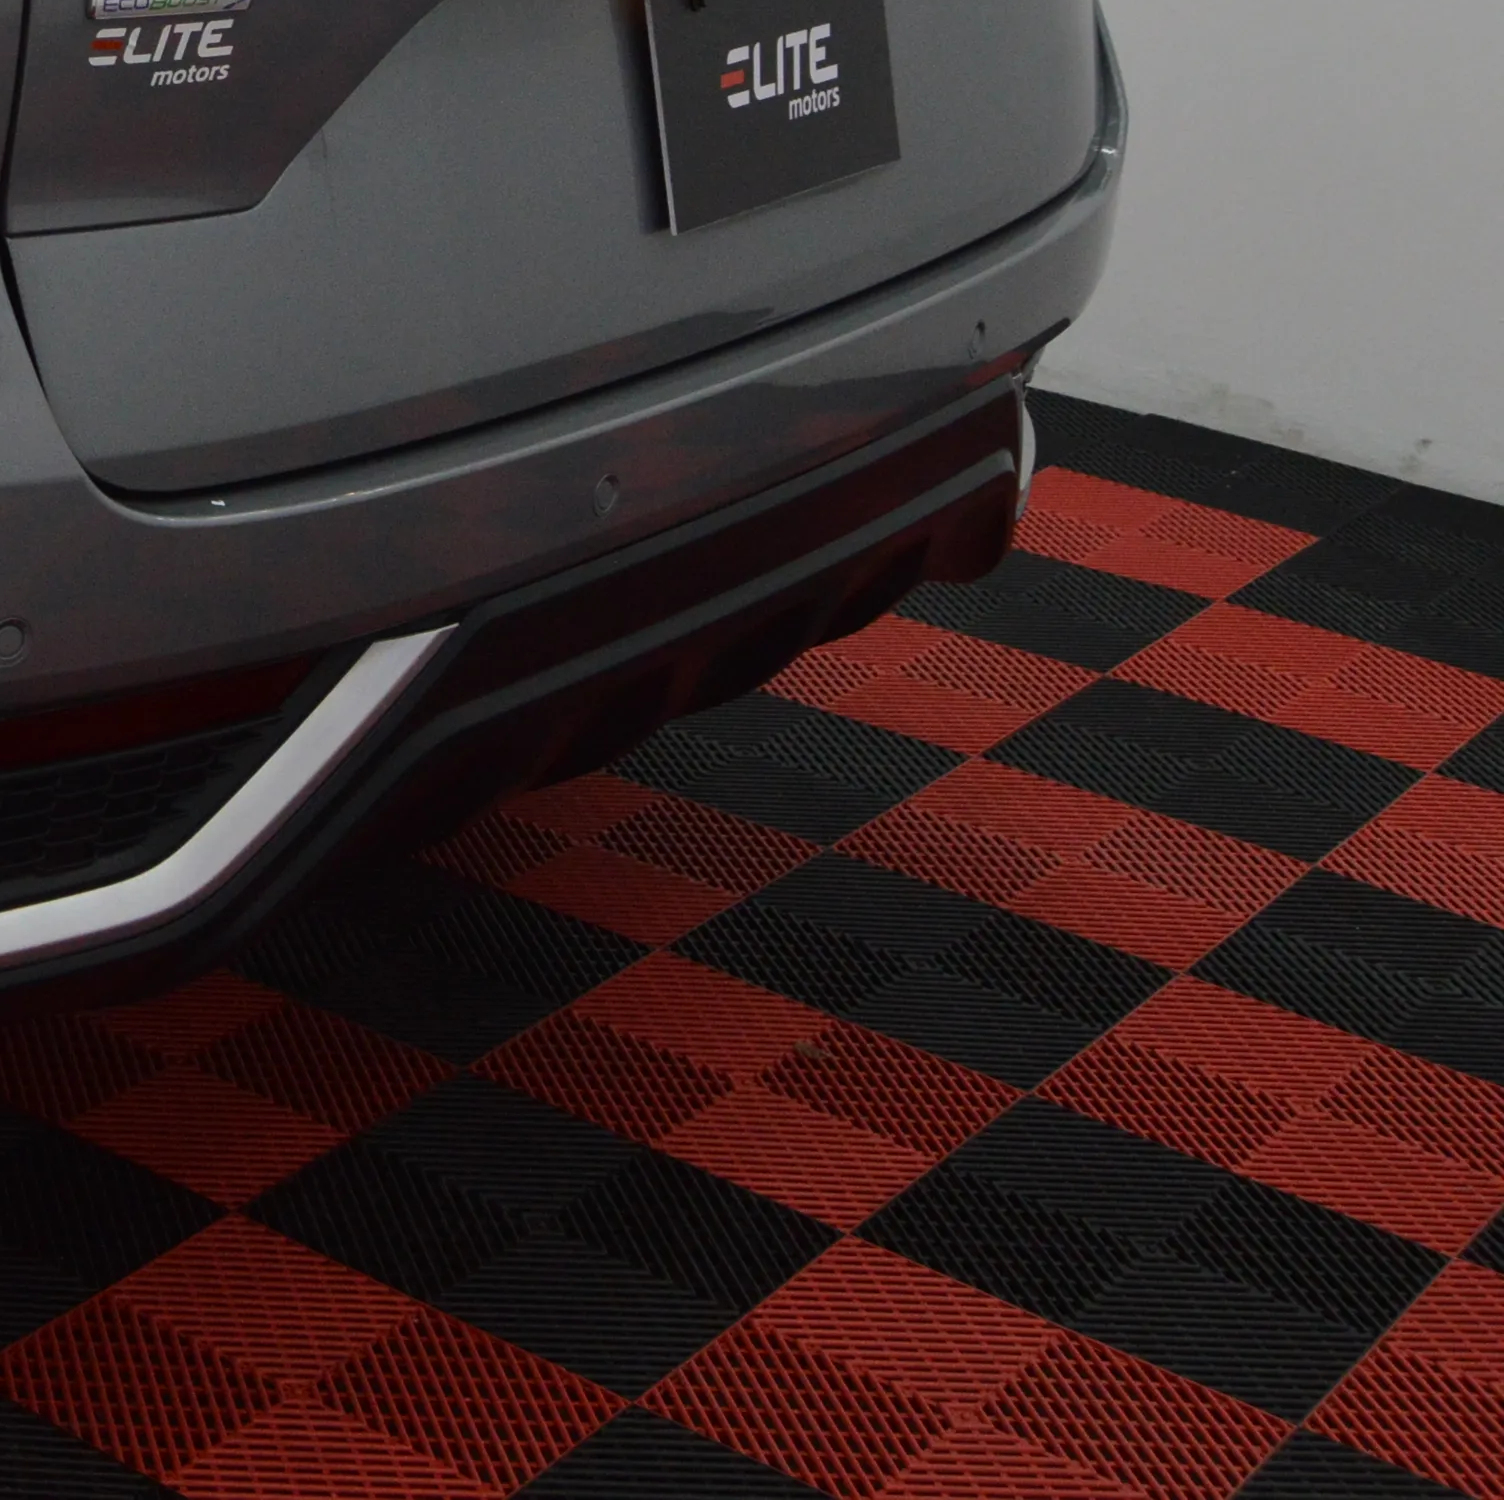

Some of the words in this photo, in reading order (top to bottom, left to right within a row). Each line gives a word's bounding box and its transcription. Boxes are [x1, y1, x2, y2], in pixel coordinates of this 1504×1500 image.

[88, 18, 234, 67] ELITE
[150, 64, 231, 88] motors
[720, 22, 838, 109] ELITE
[788, 86, 841, 121] motors
